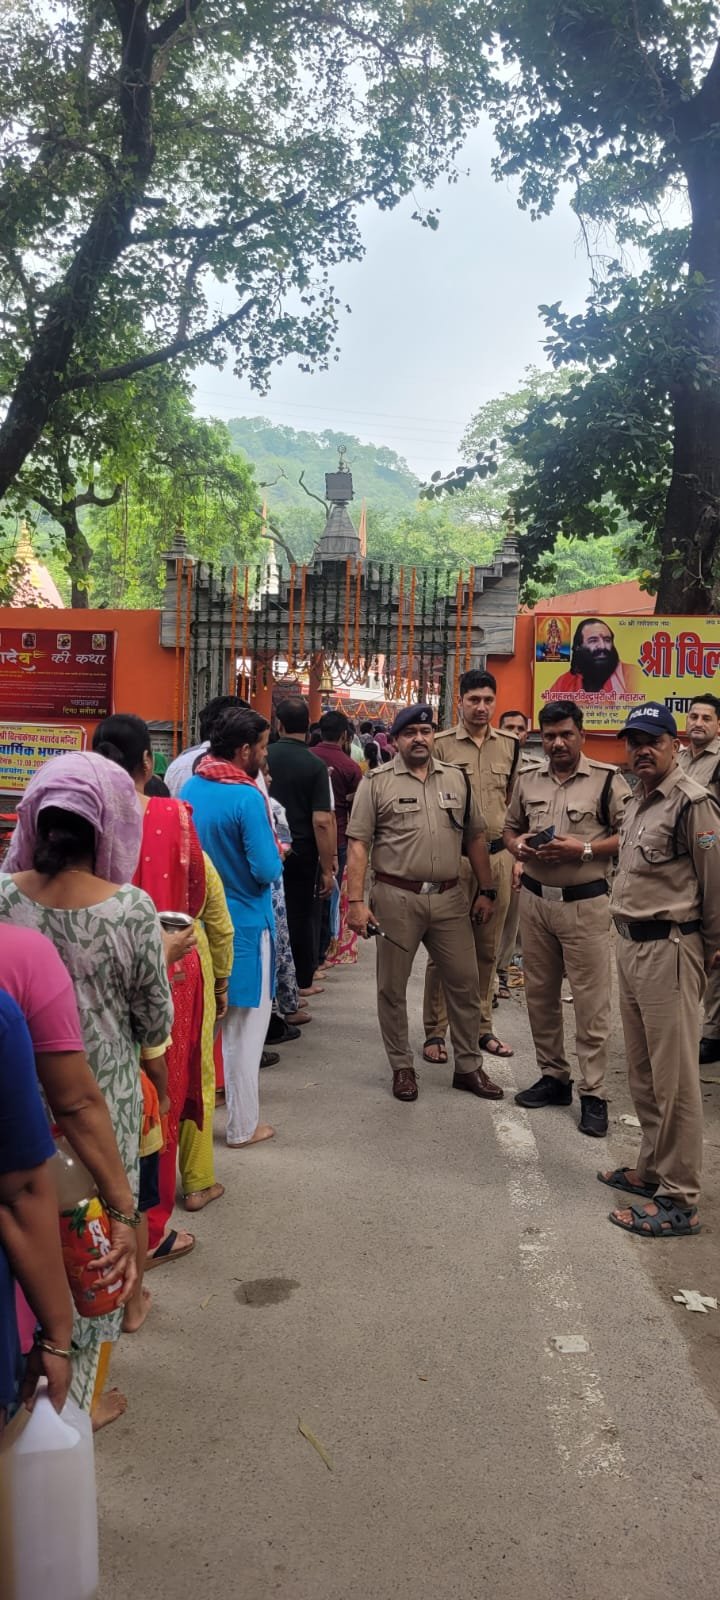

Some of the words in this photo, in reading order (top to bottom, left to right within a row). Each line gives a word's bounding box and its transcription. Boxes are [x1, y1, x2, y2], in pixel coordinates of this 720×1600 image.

[51, 651, 71, 665] की
[75, 653, 107, 665] कथा
[638, 631, 675, 678] श्री
[540, 690, 550, 702] श्री
[607, 690, 617, 701] जी
[617, 693, 646, 702] महाराज
[629, 707, 660, 720] POLICE
